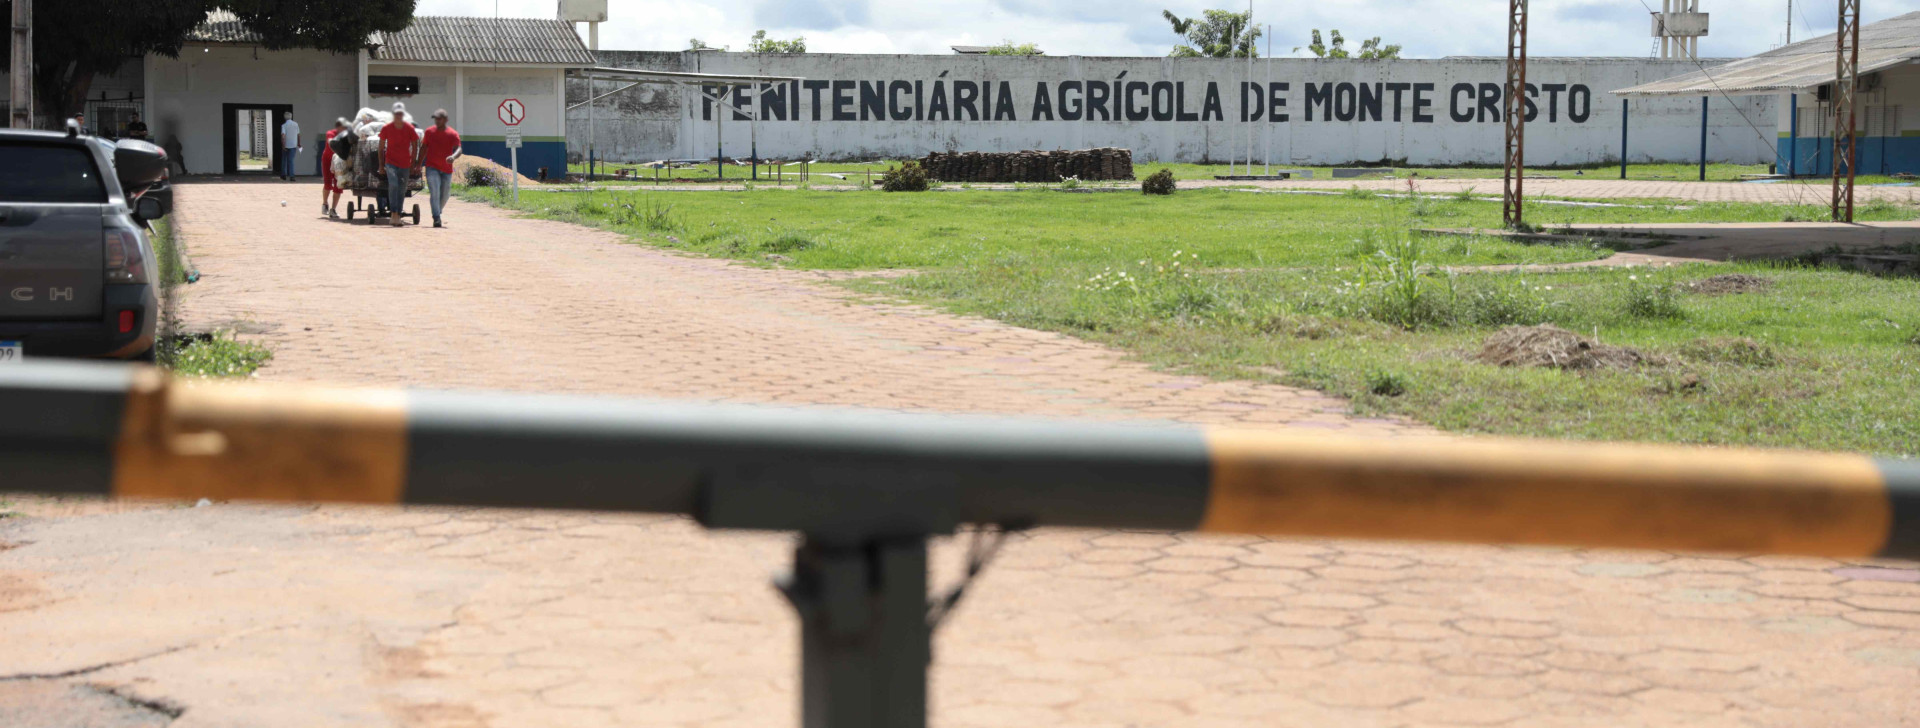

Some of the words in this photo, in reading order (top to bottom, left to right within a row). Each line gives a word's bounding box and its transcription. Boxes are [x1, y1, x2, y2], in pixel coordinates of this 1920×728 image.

[702, 70, 1017, 121] PENITENCIÁRIA
[1032, 70, 1224, 122] AGRÍCOLA
[1241, 82, 1290, 122] DE
[1304, 82, 1434, 123] MONTE
